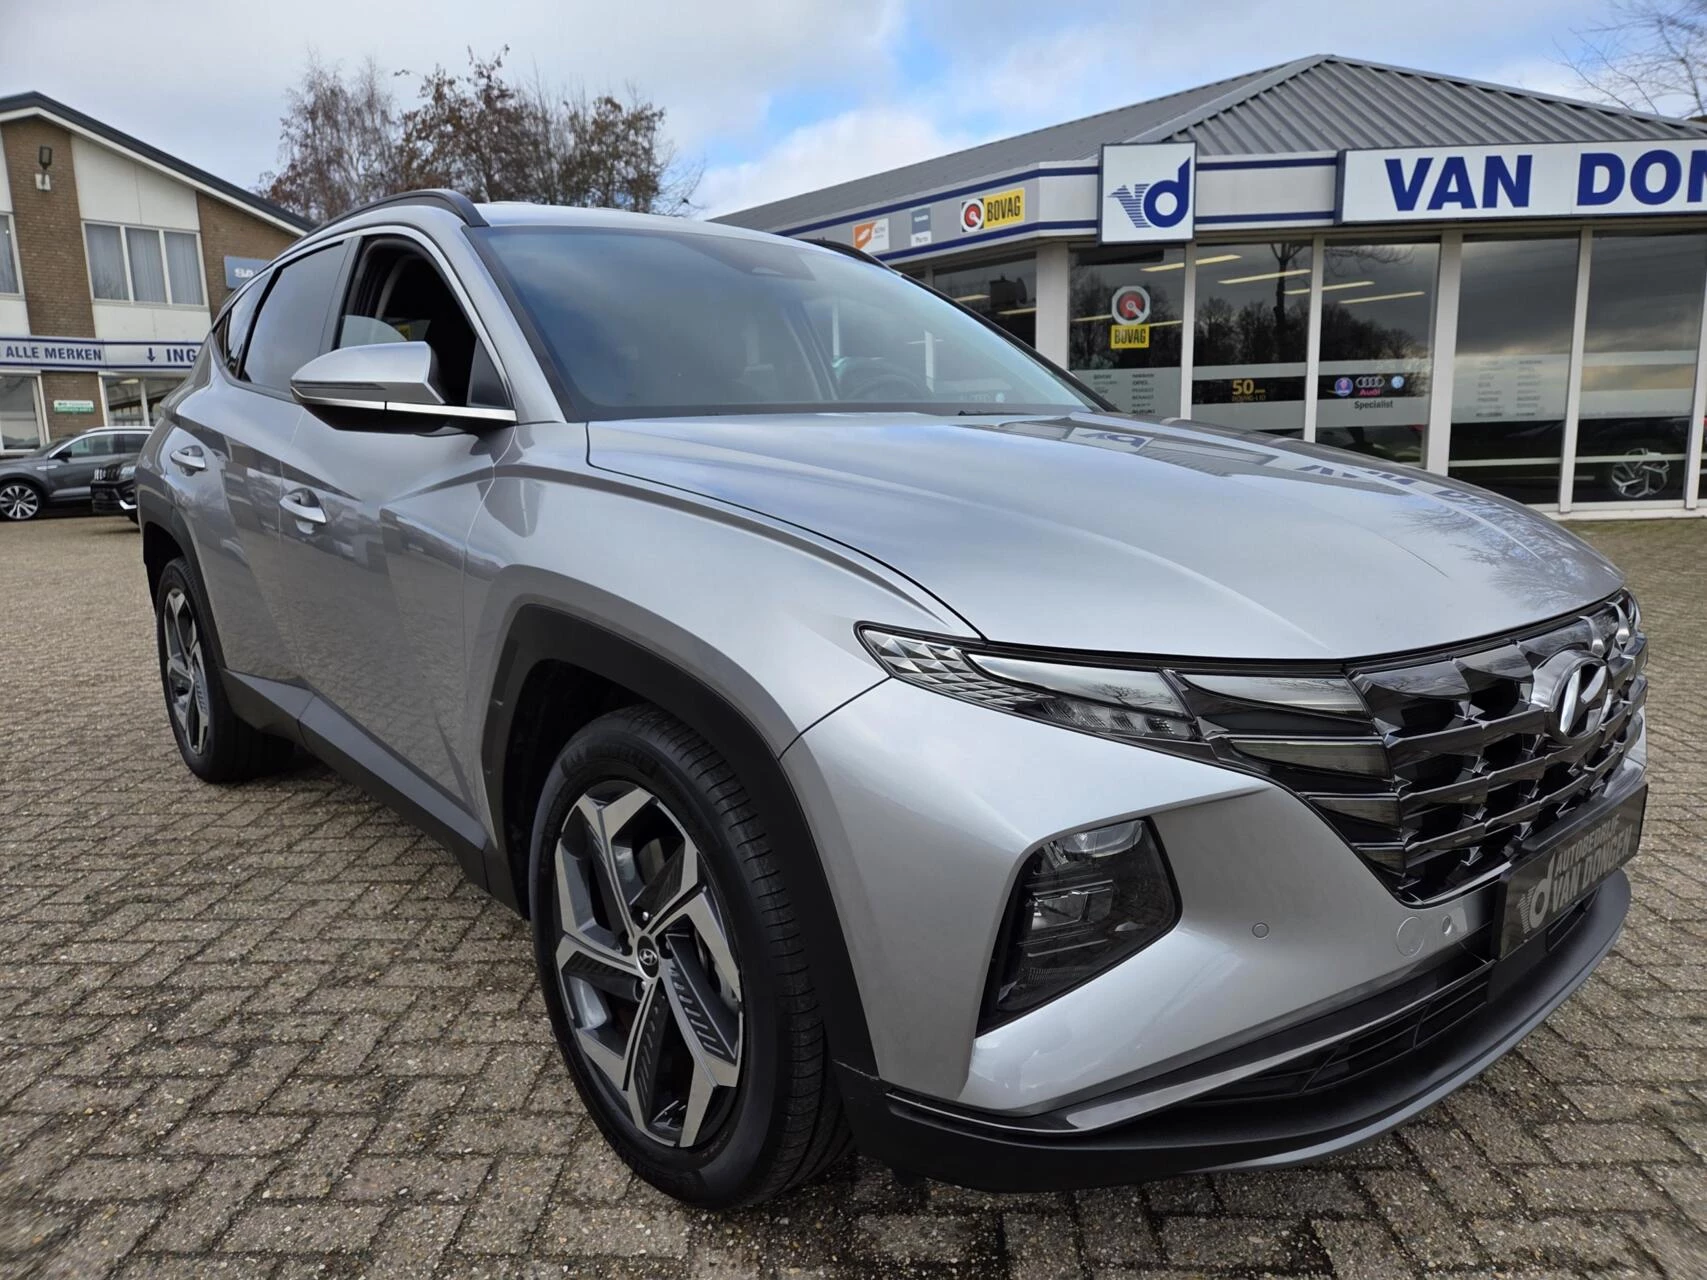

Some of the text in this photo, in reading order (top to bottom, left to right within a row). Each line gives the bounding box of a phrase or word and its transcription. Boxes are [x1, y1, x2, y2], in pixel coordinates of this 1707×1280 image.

[1384, 154, 1534, 212] VAN
[986, 195, 1021, 222] BOVAG
[1114, 327, 1147, 345] BOVAG
[6, 346, 102, 361] ALLE MERKEN
[1232, 379, 1254, 395] 50
[1360, 388, 1381, 397] Audi
[1354, 400, 1394, 410] Specialist
[1553, 861, 1582, 913] VAN
